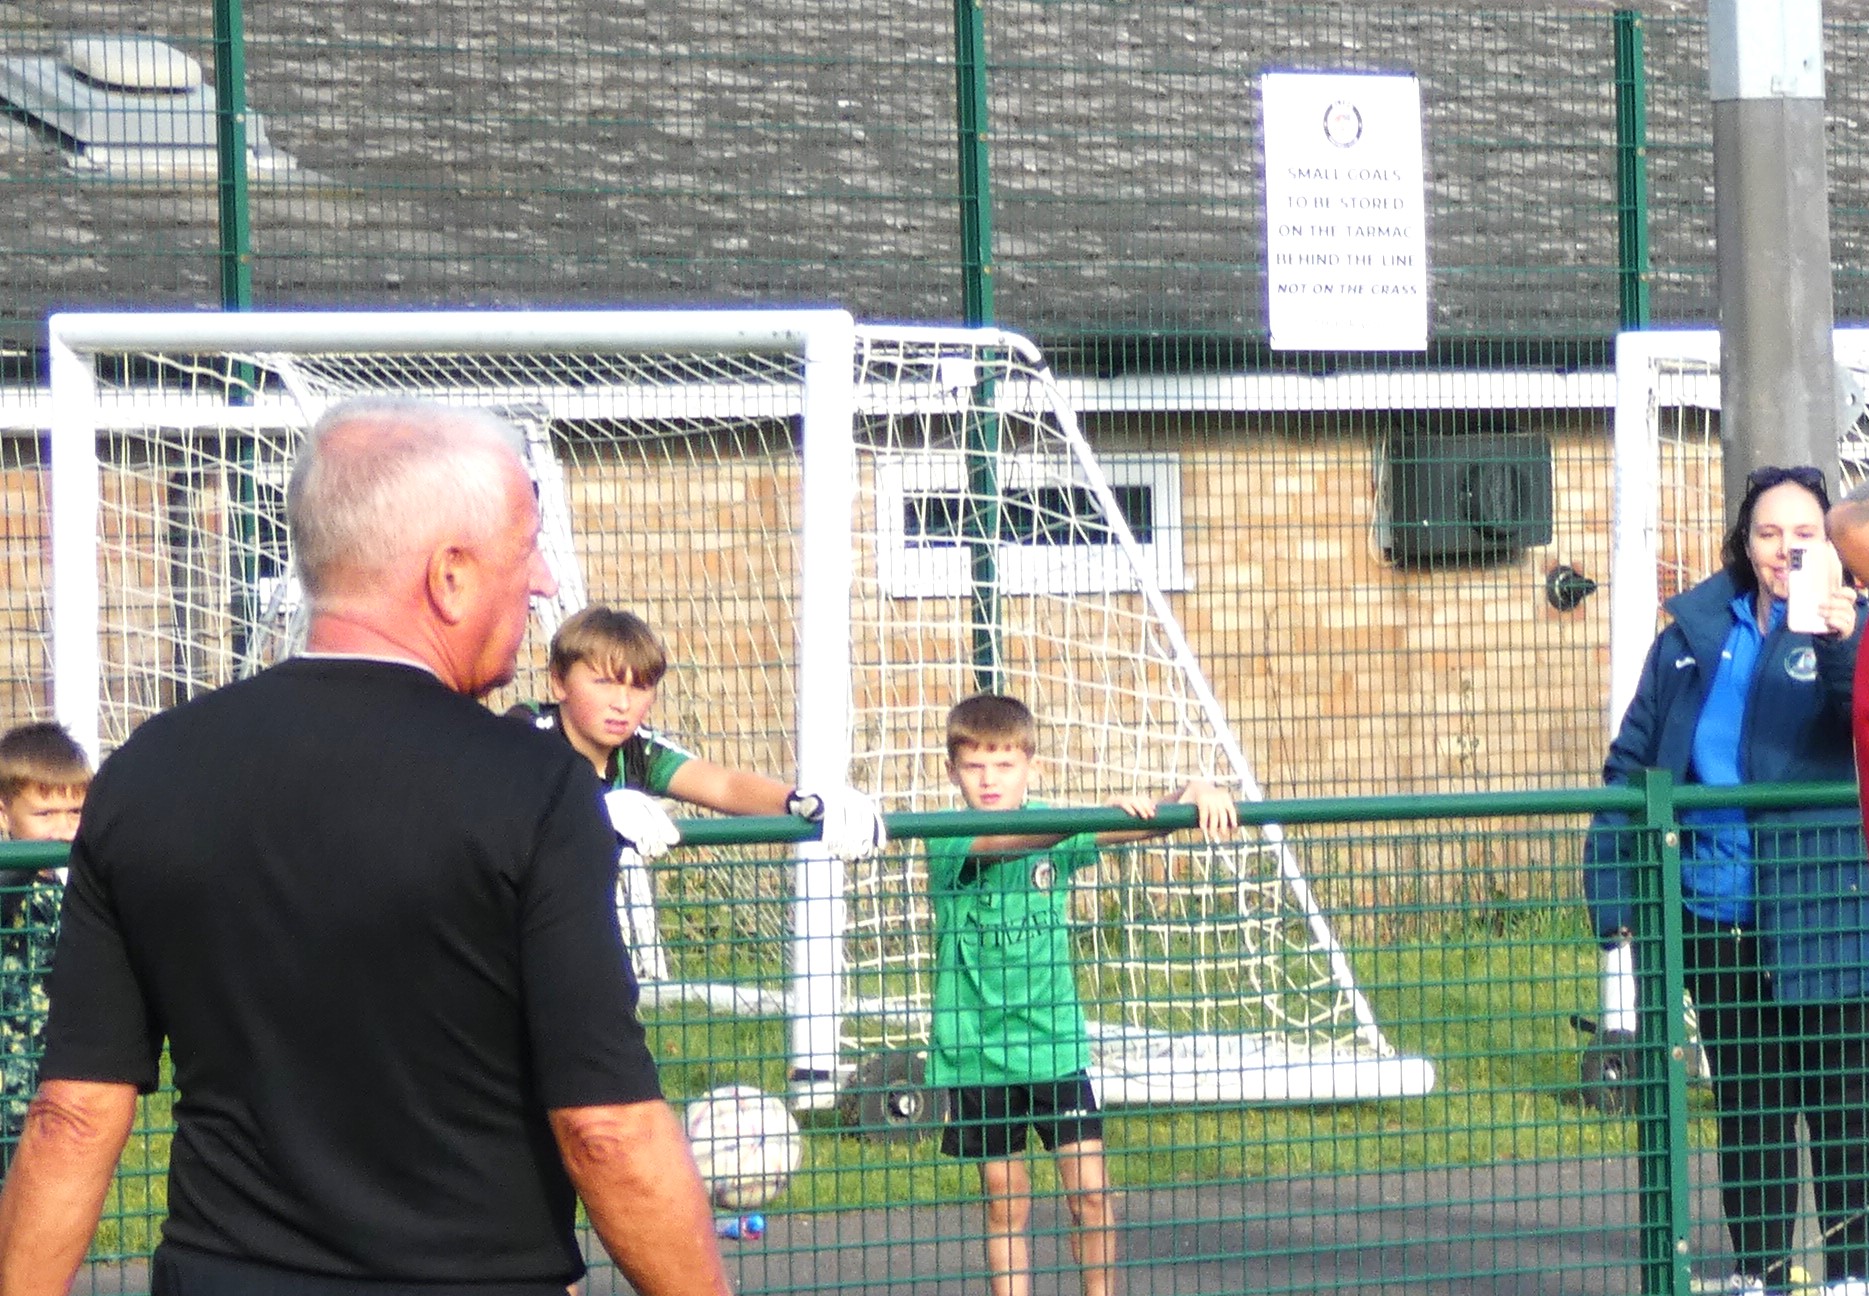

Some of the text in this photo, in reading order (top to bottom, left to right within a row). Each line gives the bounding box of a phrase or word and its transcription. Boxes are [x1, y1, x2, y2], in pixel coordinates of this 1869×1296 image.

[1288, 168, 1401, 181] SMALL GOALS
[1288, 196, 1404, 210] TO BE STORED
[1279, 225, 1412, 238] ON THE TARMAC
[1276, 253, 1415, 267] BEHIND THE LINE
[1277, 284, 1417, 295] NOT ON THE GRASS
